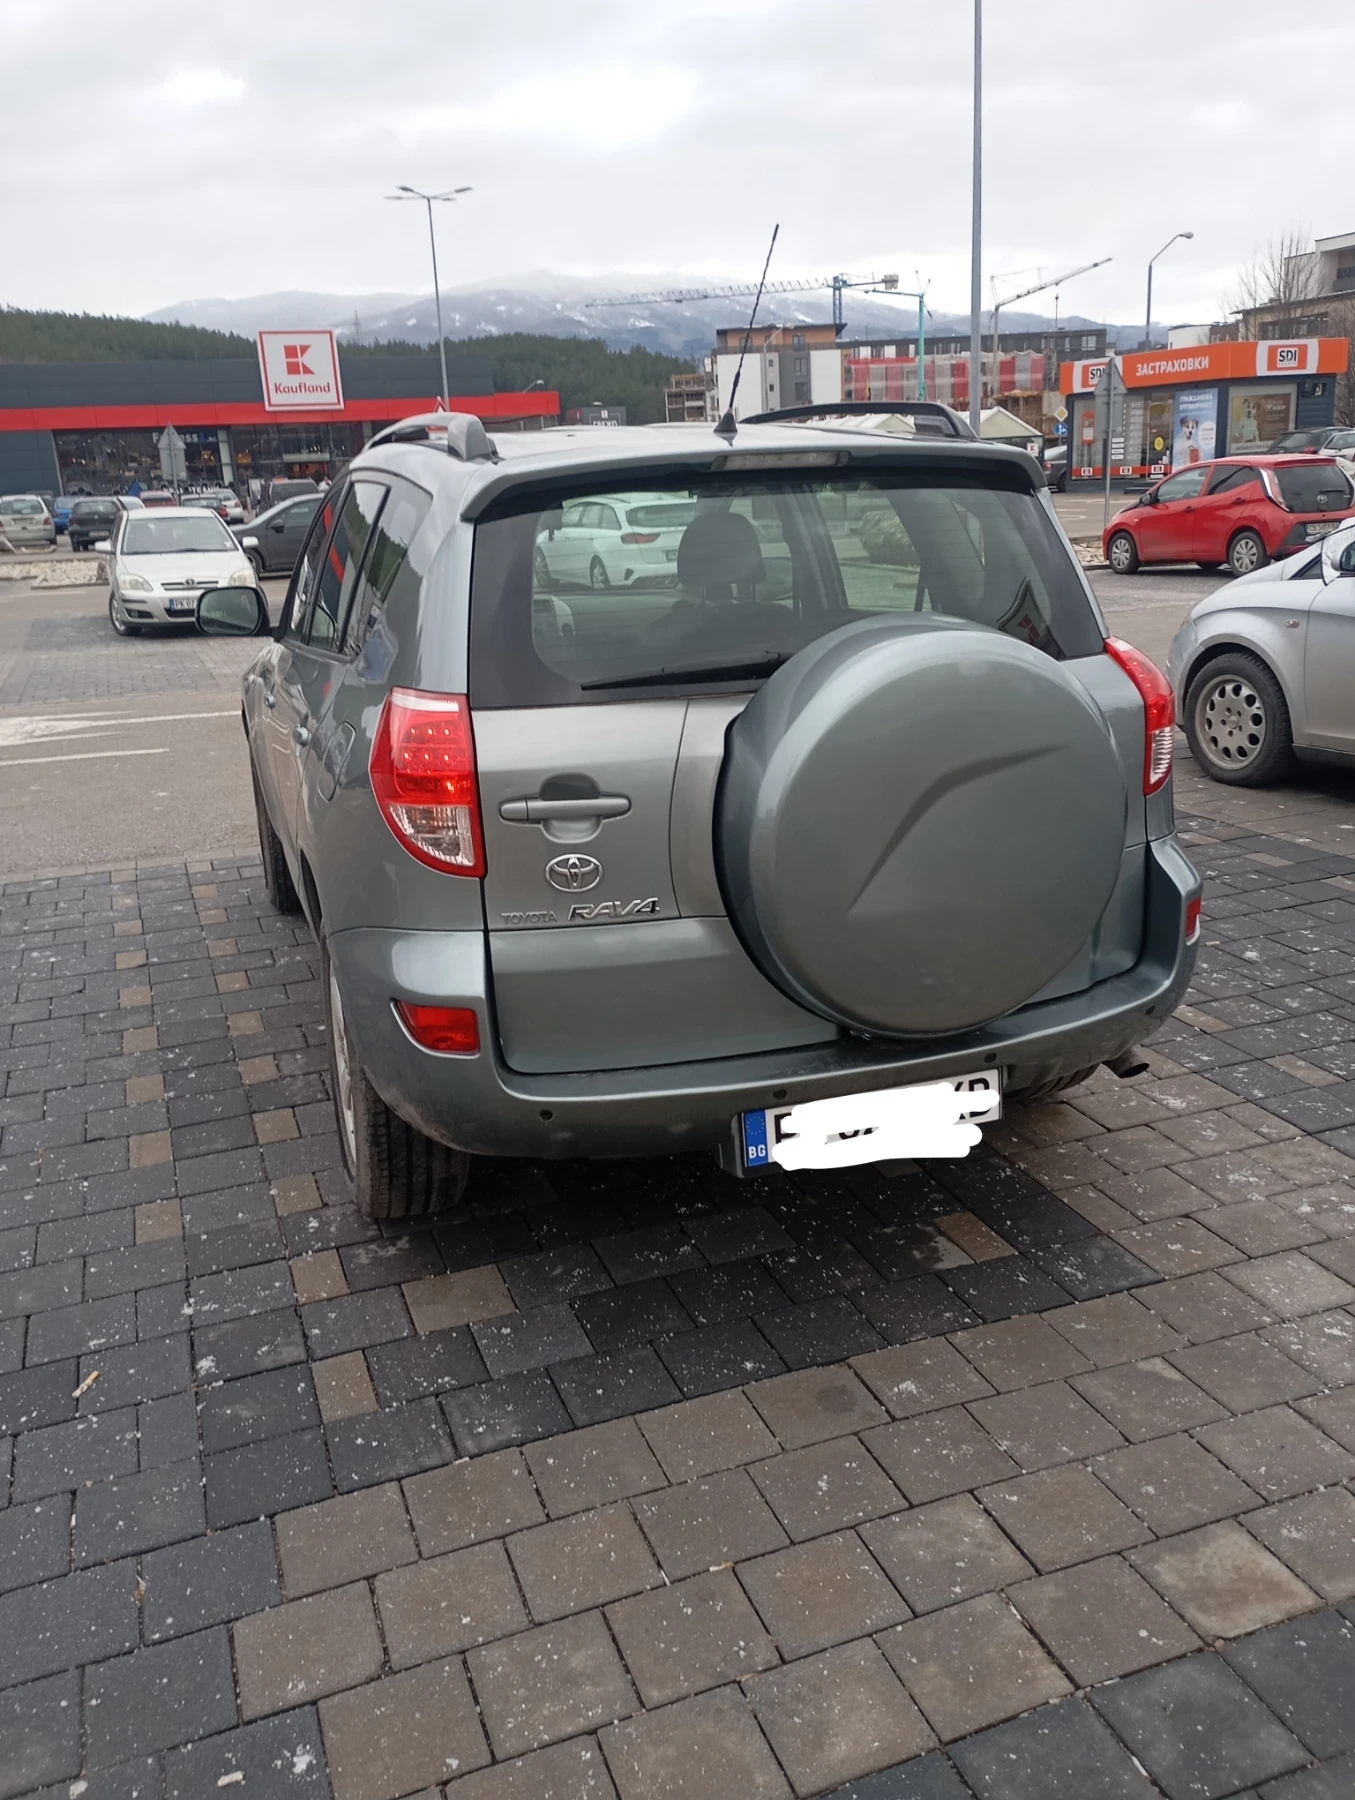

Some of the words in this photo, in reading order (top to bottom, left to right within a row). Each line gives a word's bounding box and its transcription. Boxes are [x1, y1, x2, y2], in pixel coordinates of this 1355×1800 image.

[1278, 349, 1297, 363] SDI
[1136, 355, 1210, 377] ЗАСТРАХОВКИ
[274, 381, 331, 395] Kaufland
[501, 910, 557, 925] TOYOTA
[568, 896, 661, 922] RAV4
[748, 1144, 766, 1159] BG
